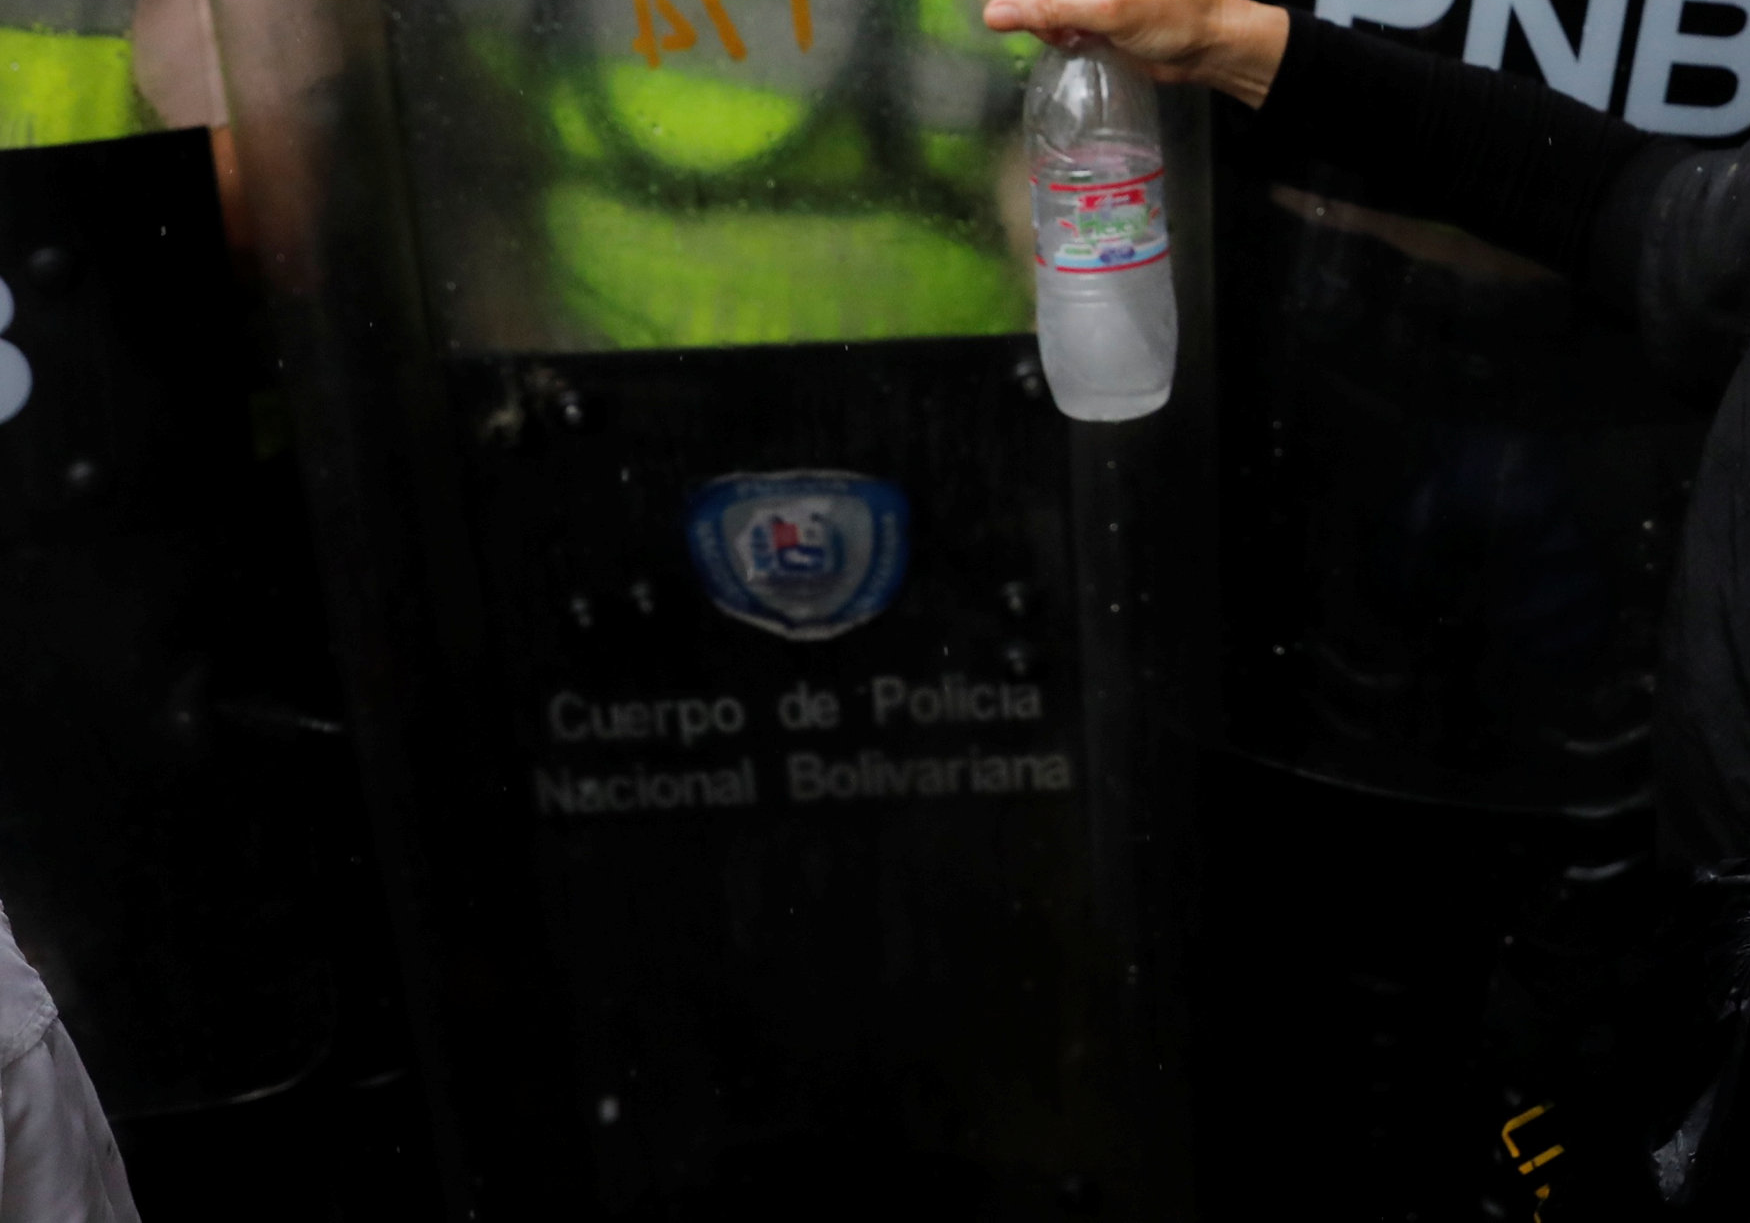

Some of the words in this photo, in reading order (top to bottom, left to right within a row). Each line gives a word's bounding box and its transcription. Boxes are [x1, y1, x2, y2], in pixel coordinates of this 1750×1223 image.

[548, 689, 746, 745] Cuerpo
[777, 681, 841, 729] de
[534, 758, 758, 816] Nacional
[785, 748, 1073, 802] Bolivariana
